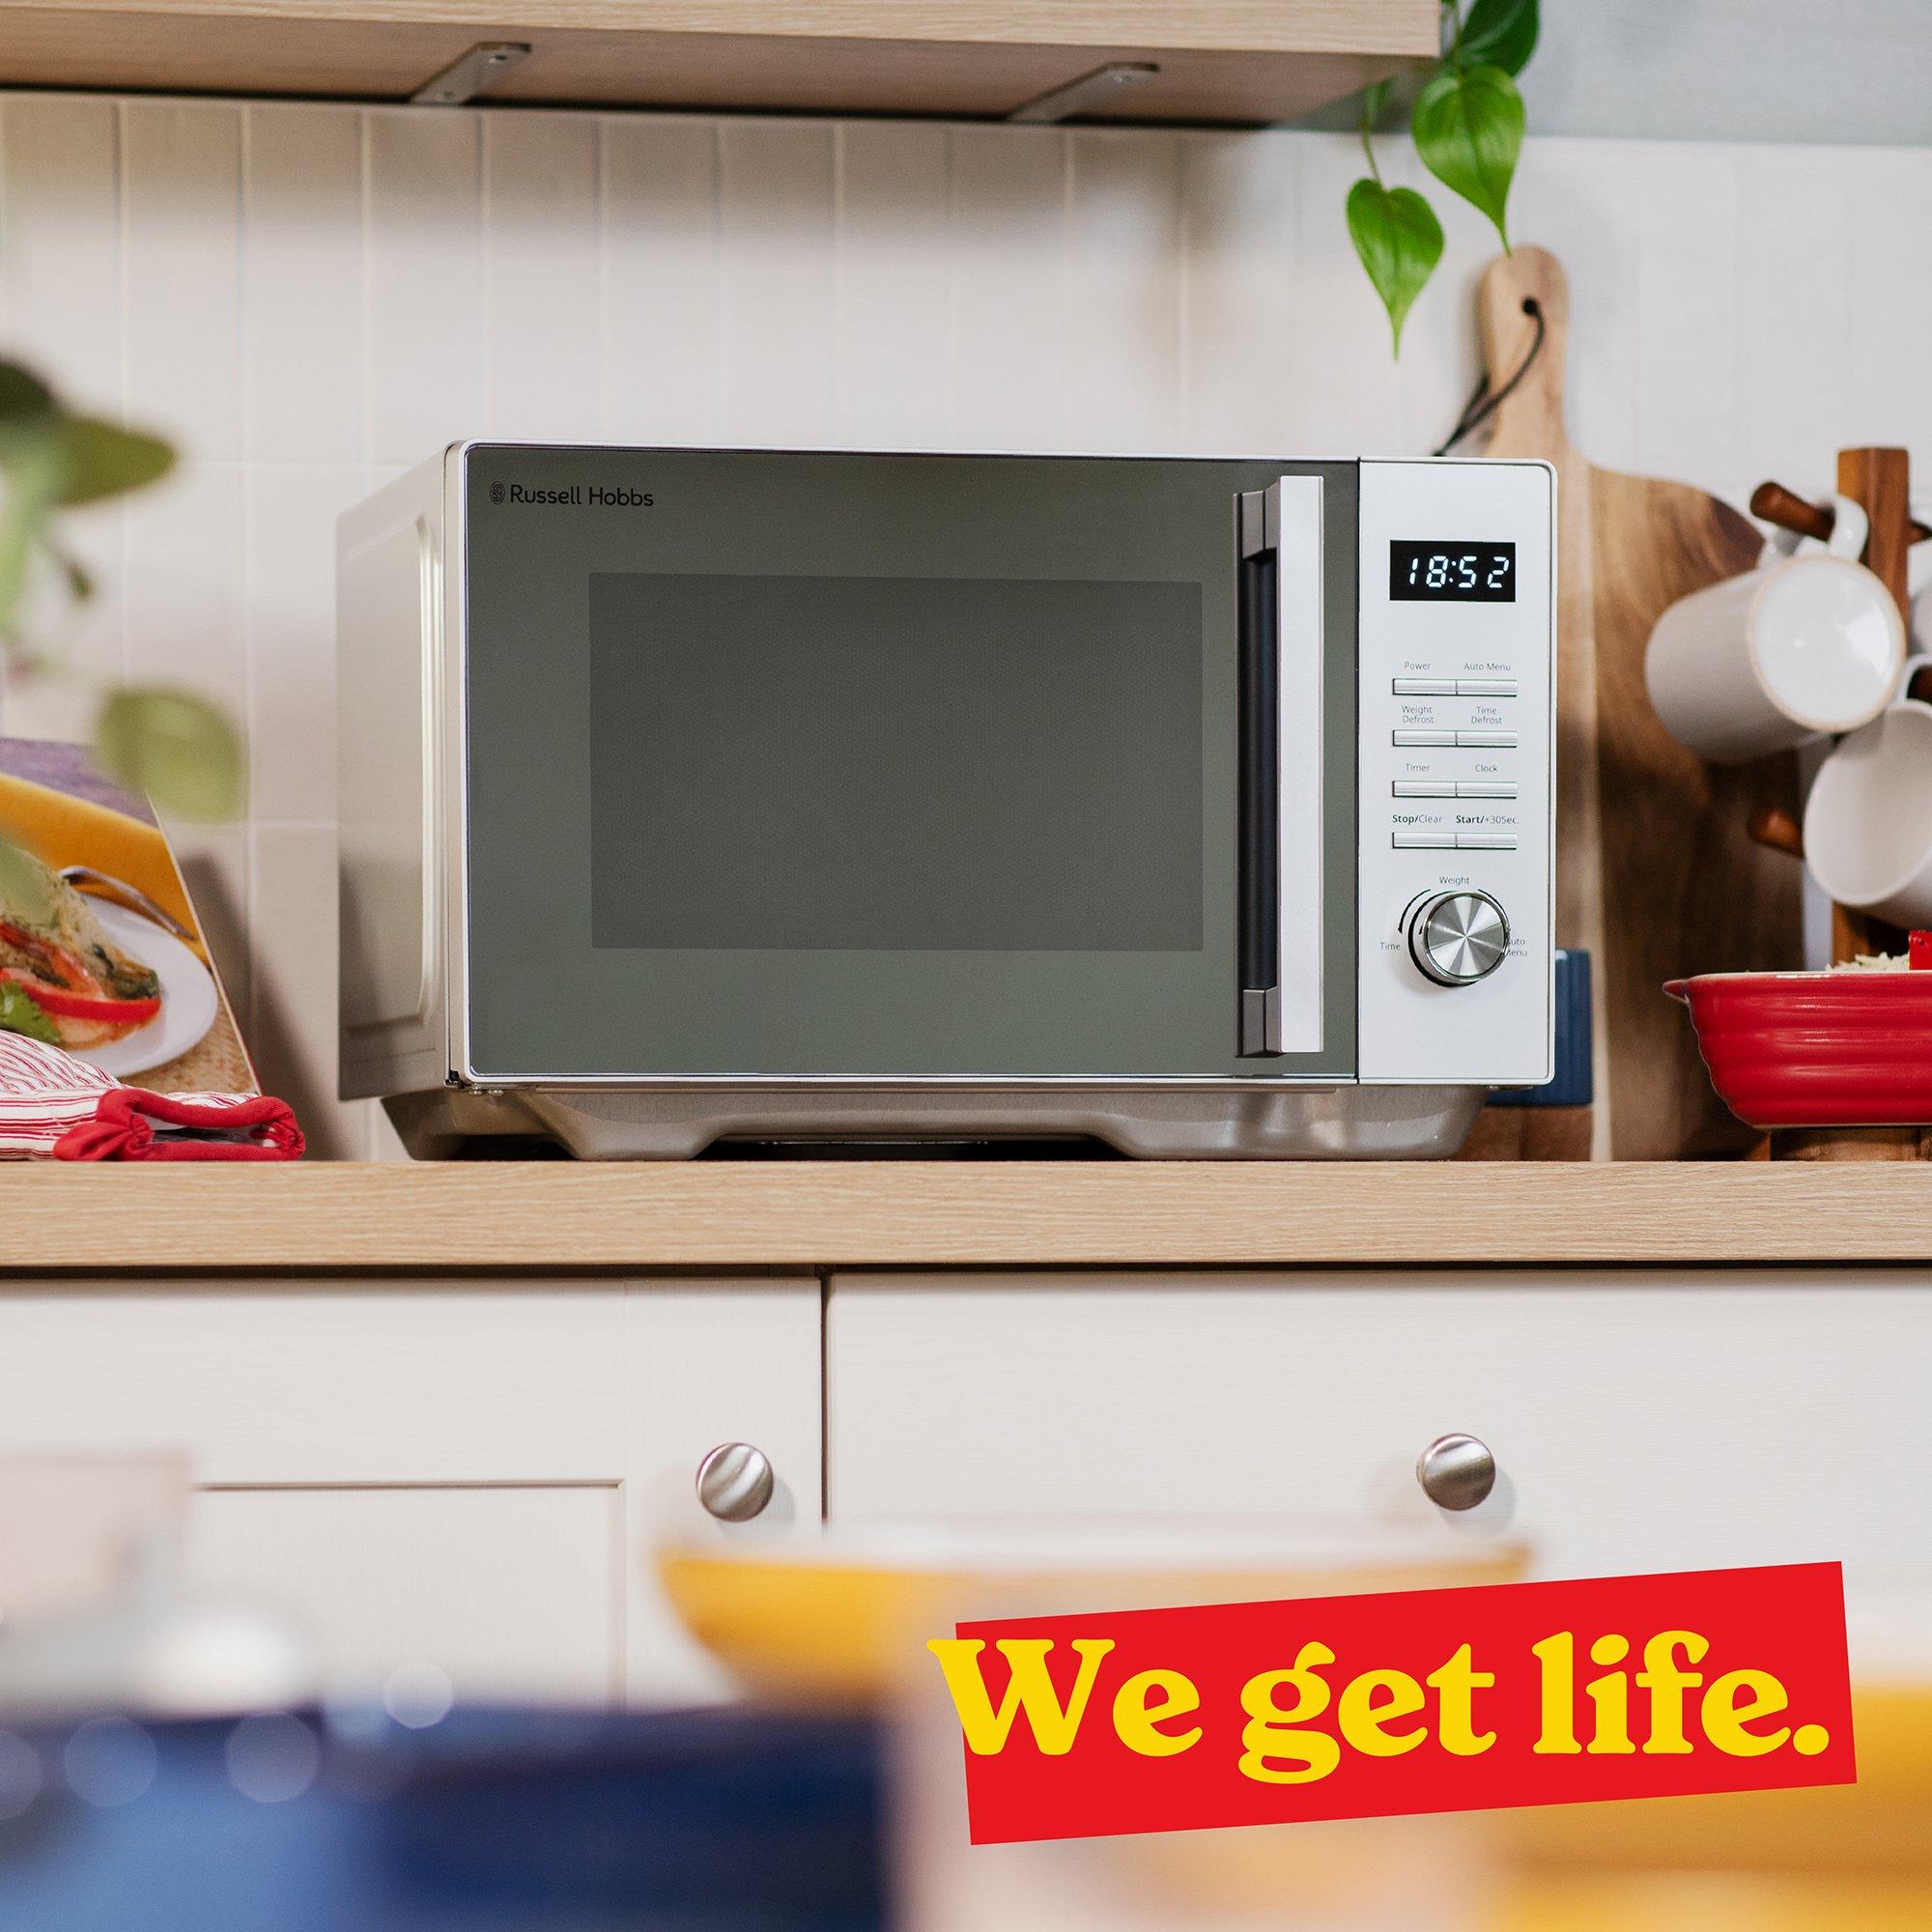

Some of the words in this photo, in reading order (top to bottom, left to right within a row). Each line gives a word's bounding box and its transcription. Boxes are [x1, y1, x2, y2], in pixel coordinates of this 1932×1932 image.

[511, 484, 582, 505] Russell
[588, 486, 654, 507] Hobbs
[1408, 555, 1510, 588] 18:52
[1404, 661, 1432, 671] Power
[1463, 662, 1485, 671] Auto
[1487, 662, 1512, 672] Menu
[1402, 705, 1433, 716] Weight
[1476, 706, 1497, 716] Time
[1402, 715, 1435, 724] Defrost
[1470, 715, 1503, 725] Defrost
[1406, 763, 1431, 773] Timer
[1474, 763, 1499, 773] Clock
[1391, 813, 1443, 826] Stop/Clear
[1438, 875, 1470, 887] Weight
[1380, 941, 1402, 952] Time
[1509, 937, 1526, 946] uto
